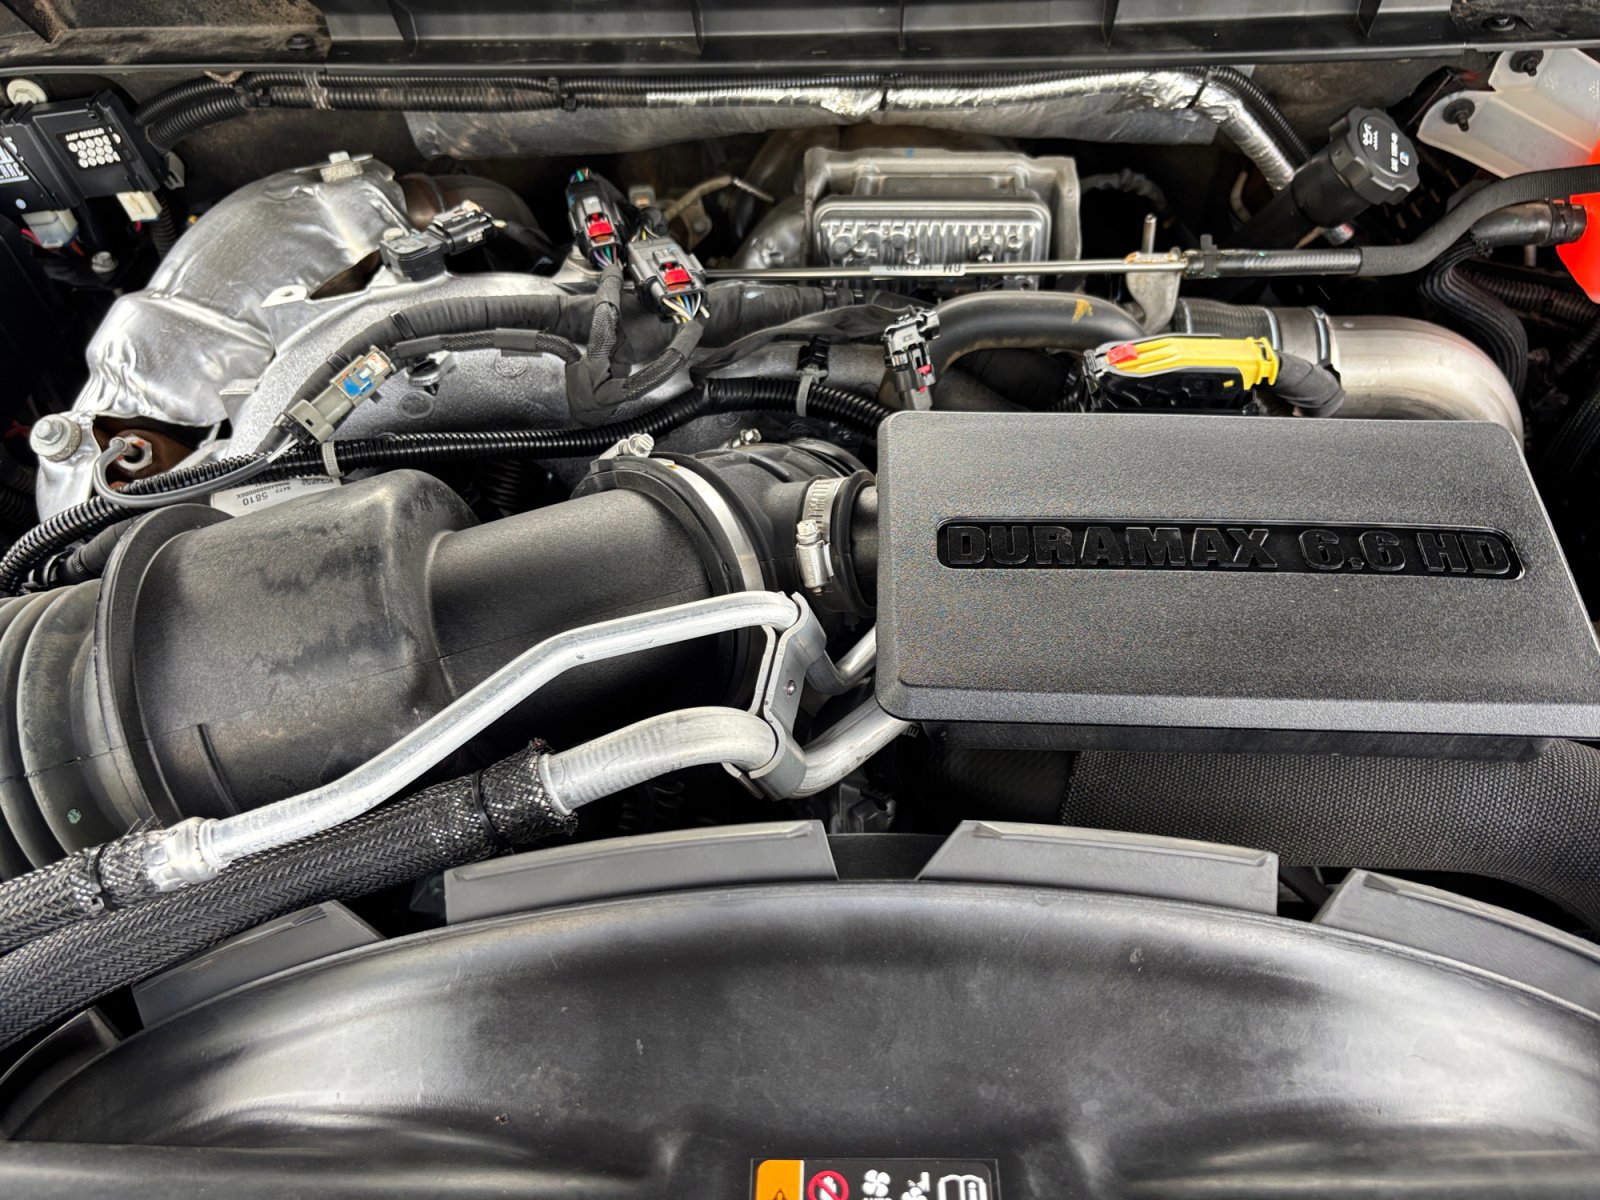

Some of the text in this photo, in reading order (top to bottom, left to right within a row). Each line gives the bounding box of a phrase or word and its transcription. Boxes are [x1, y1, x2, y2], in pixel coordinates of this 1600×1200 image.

[242, 491, 269, 506] 5810
[947, 525, 1510, 574] DURAMAX 6.6 HD
